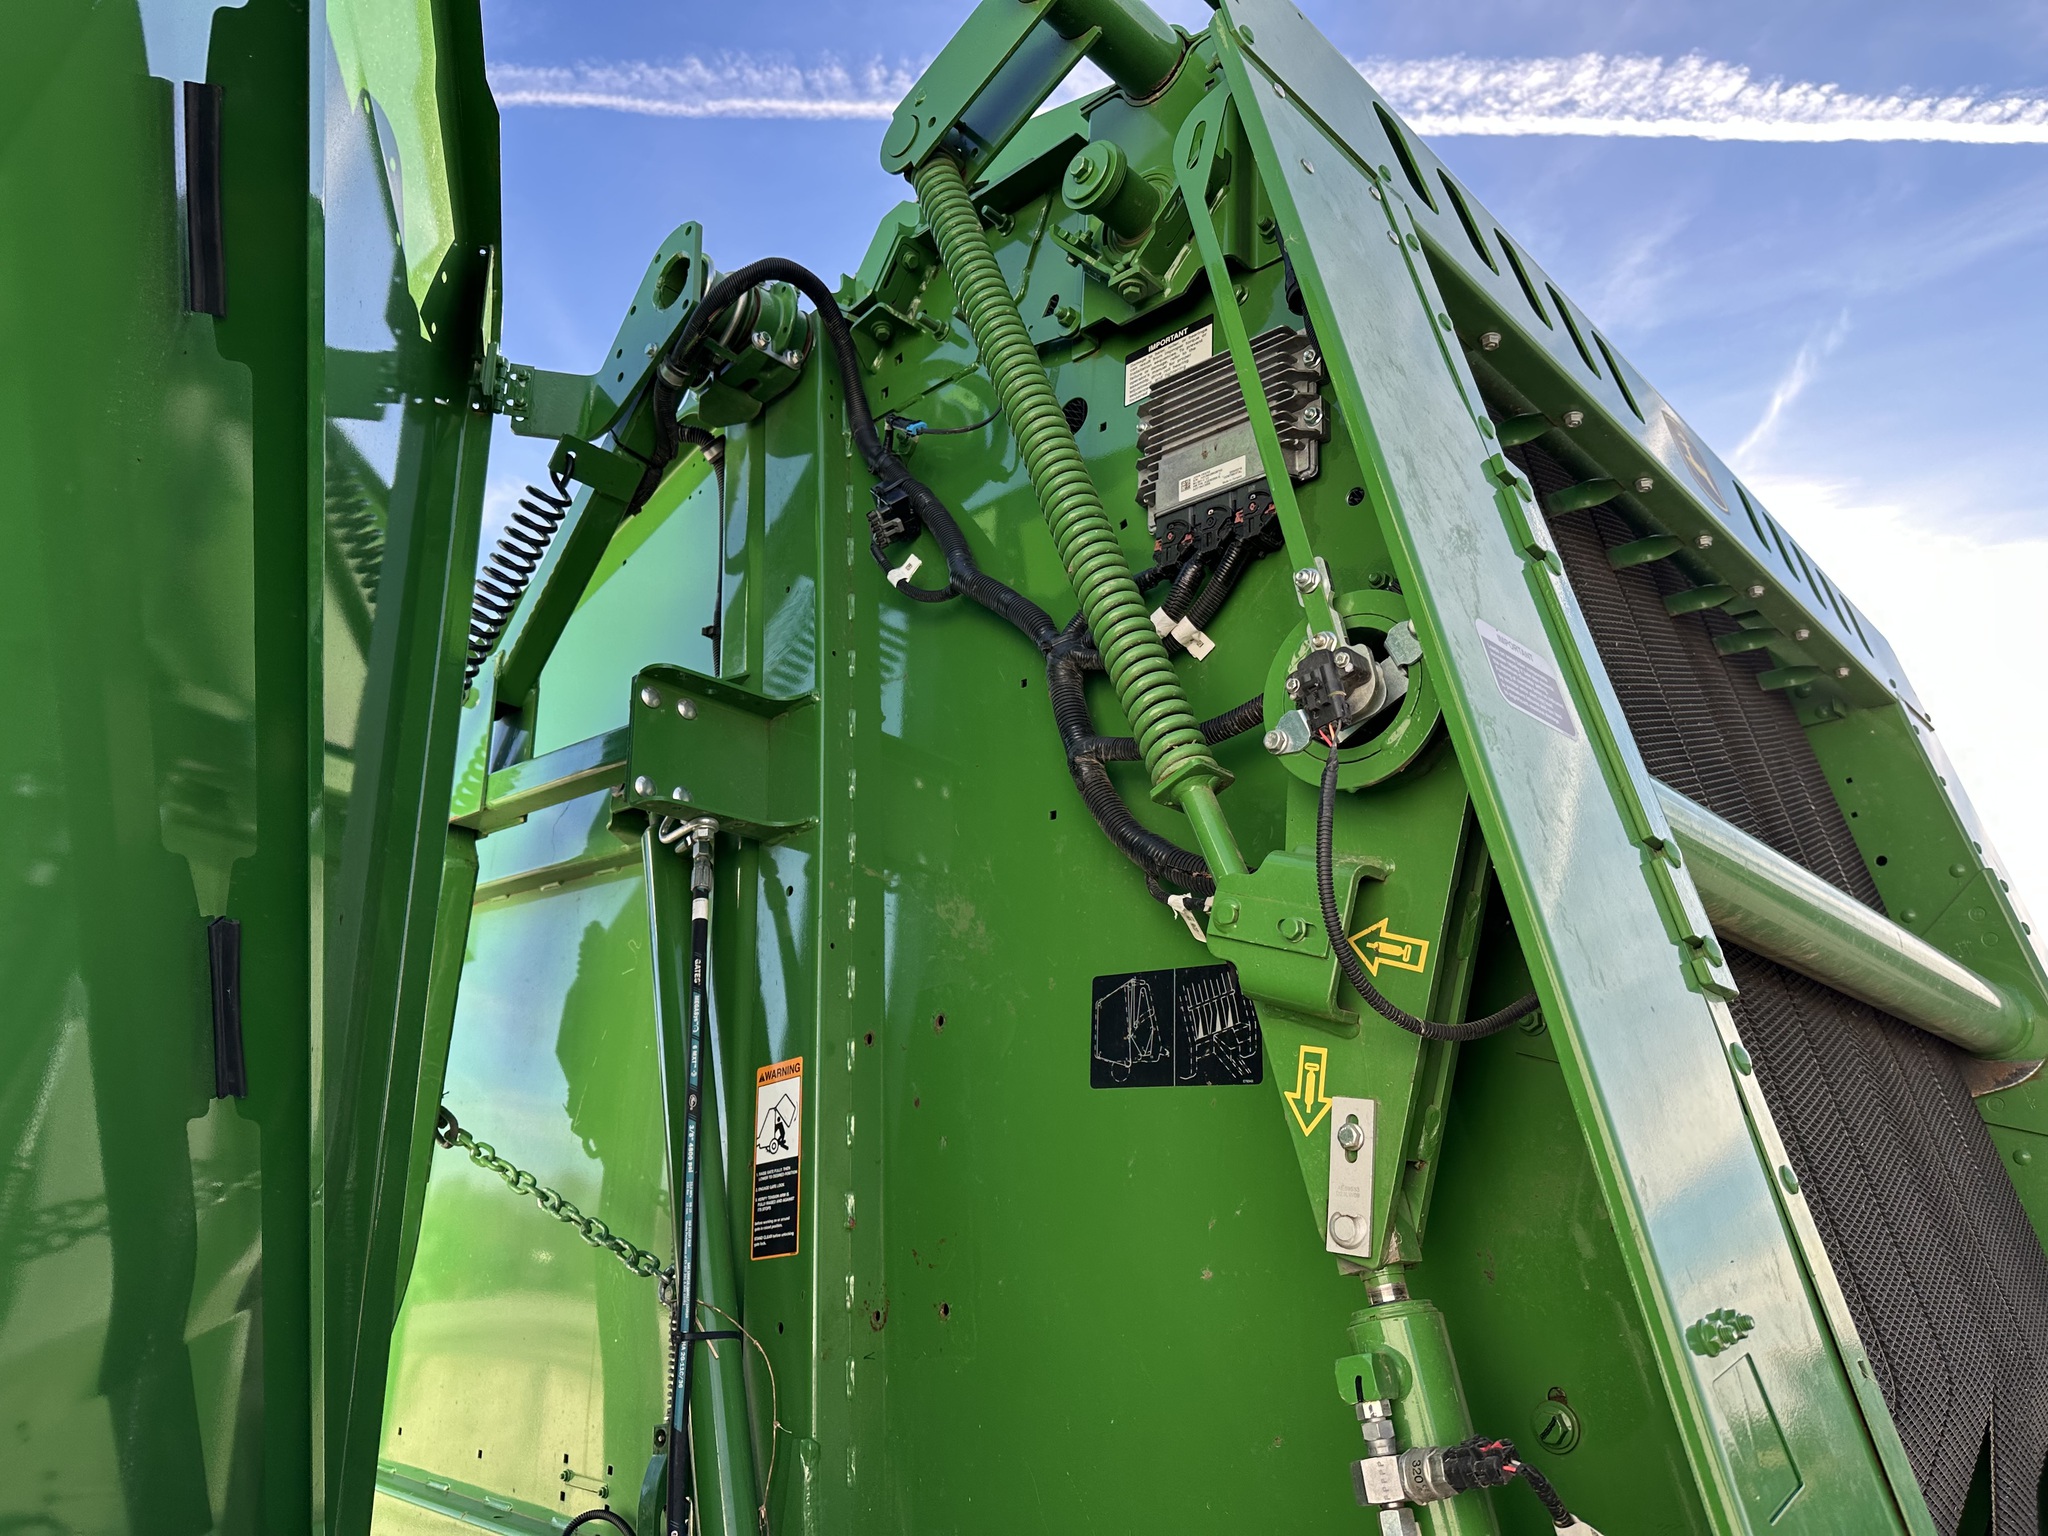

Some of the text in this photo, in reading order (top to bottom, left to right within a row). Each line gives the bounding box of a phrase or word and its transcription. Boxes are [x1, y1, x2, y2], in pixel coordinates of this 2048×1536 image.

[1148, 327, 1188, 352] IMPORTANT
[765, 1062, 800, 1081] WARNING
[1412, 1460, 1424, 1484] 320
